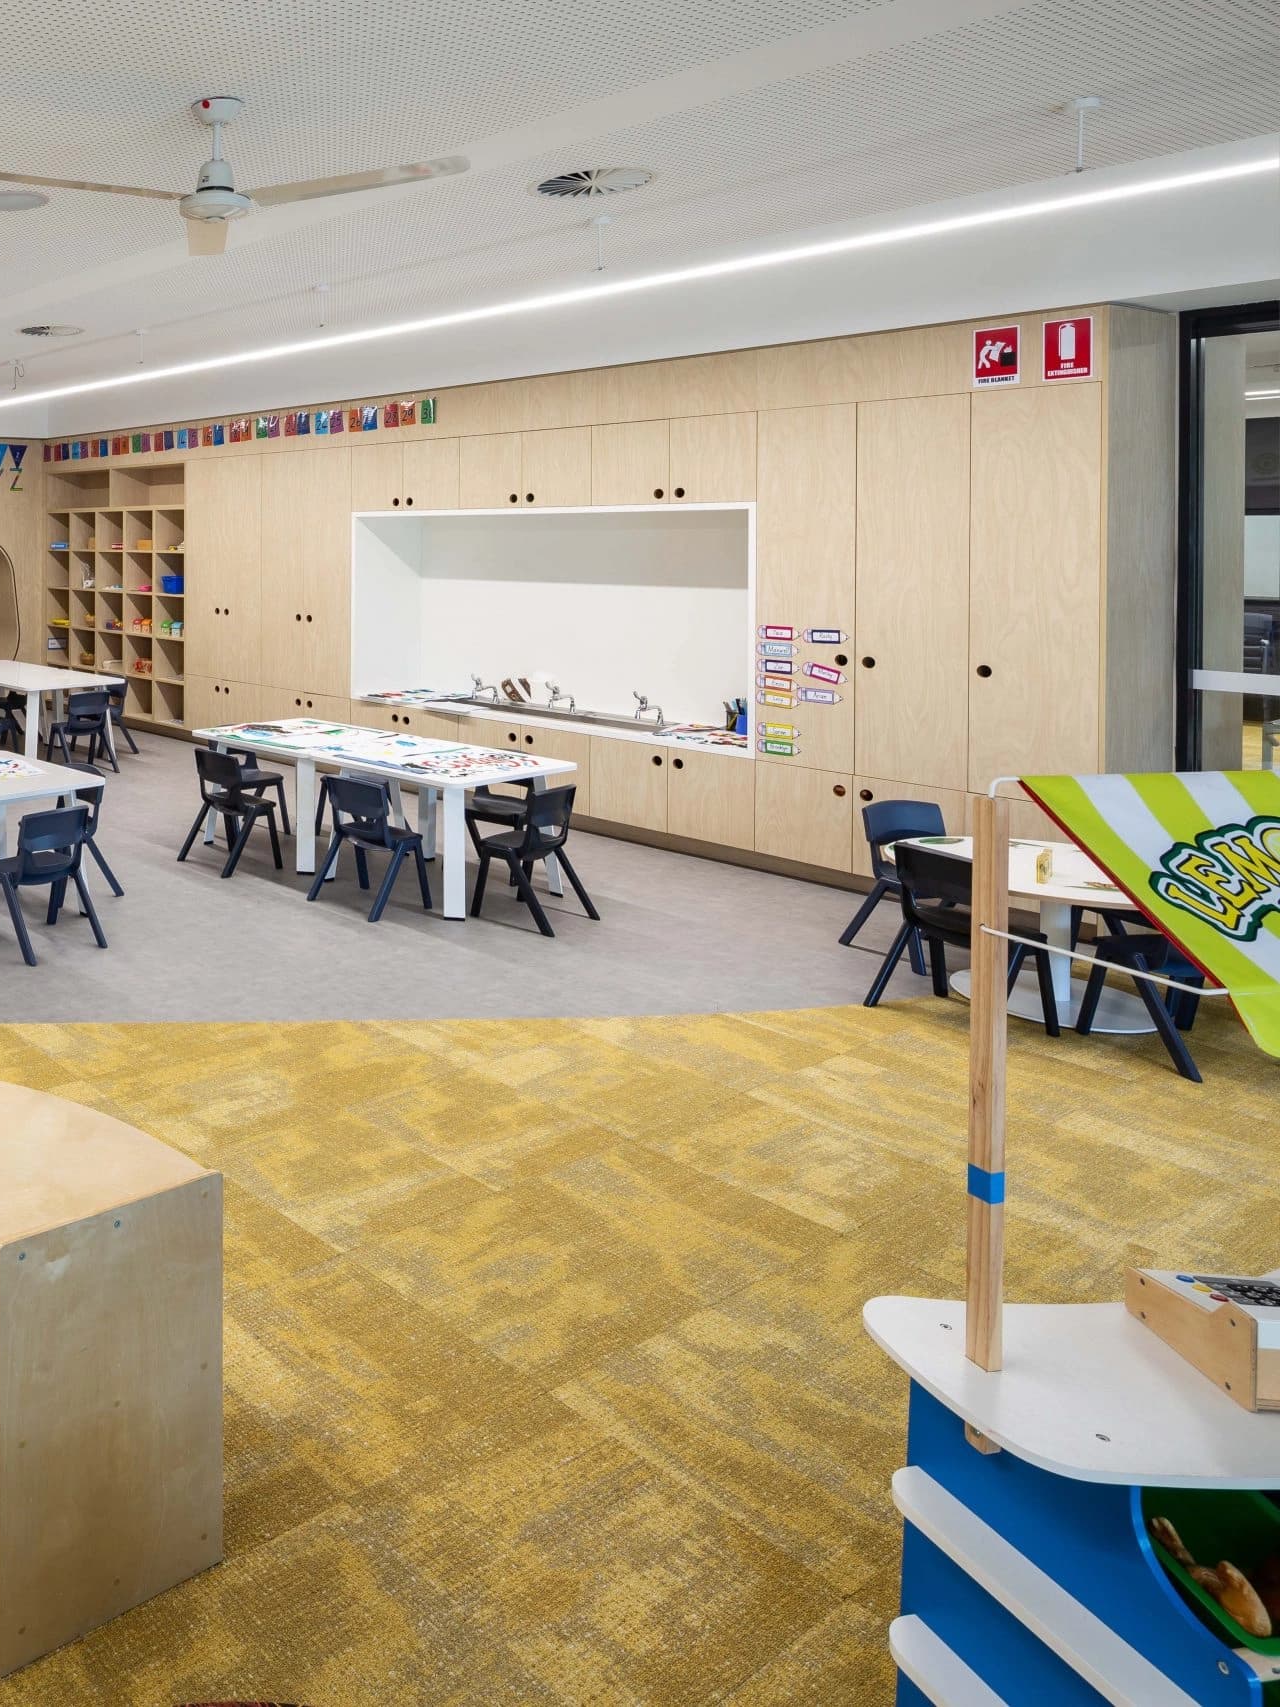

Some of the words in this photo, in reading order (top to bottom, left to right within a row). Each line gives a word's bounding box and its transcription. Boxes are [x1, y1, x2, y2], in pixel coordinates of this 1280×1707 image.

[1047, 367, 1088, 377] EXTINGUISHER
[350, 416, 362, 428] 26
[400, 408, 414, 422] 29
